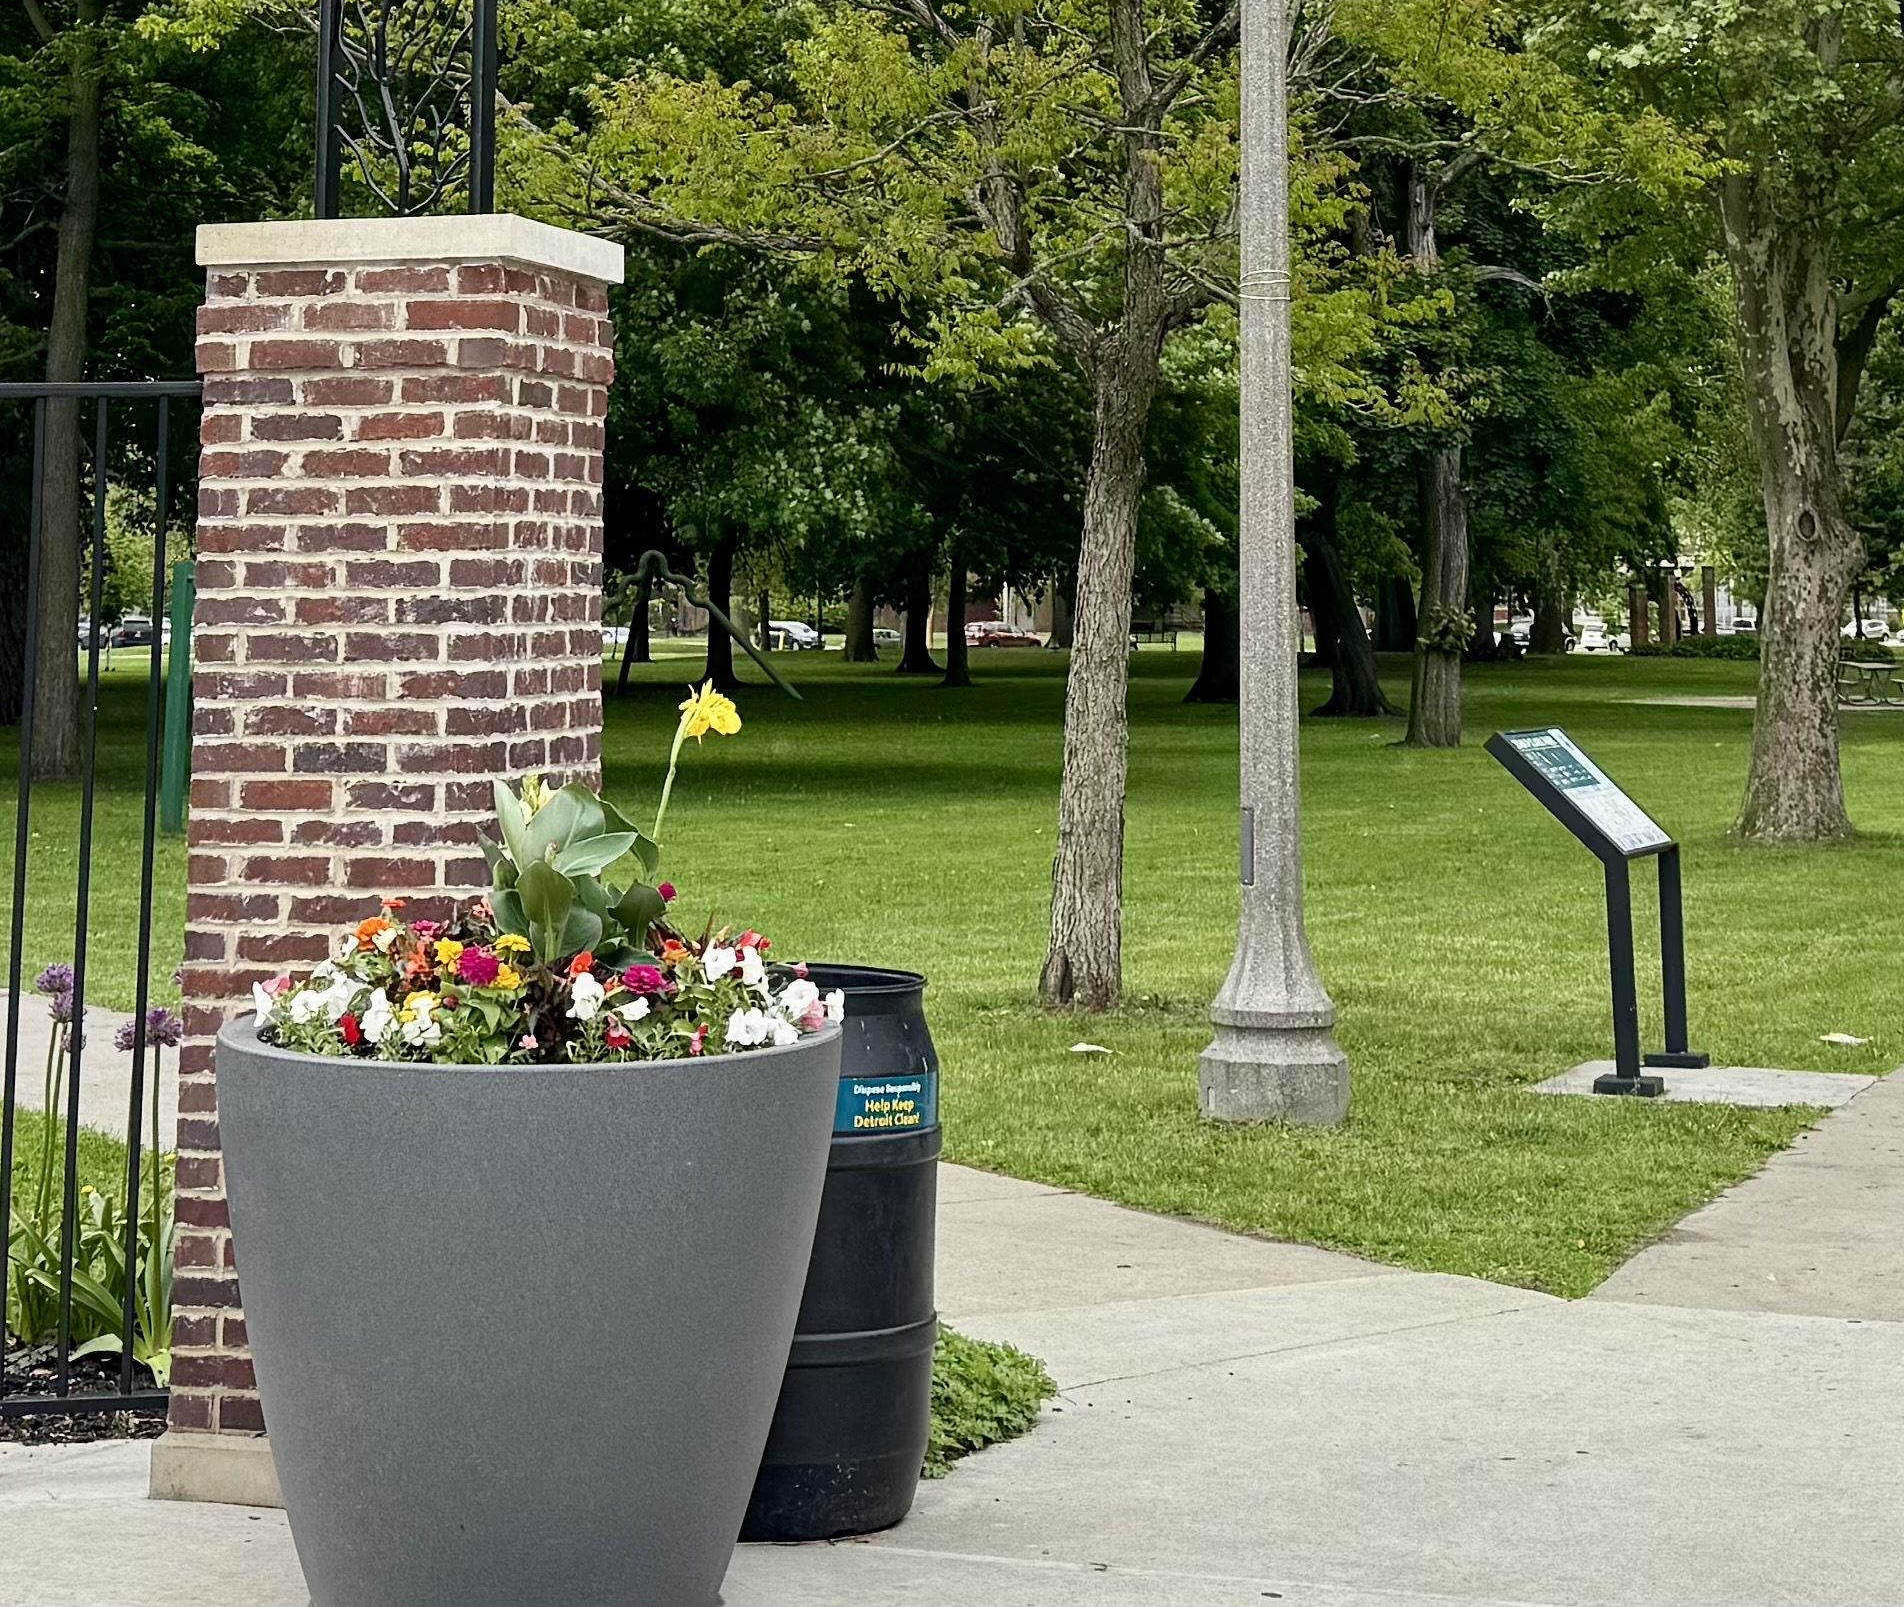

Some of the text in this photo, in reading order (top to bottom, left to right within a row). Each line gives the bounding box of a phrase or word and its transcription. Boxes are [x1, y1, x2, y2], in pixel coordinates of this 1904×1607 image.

[853, 1084, 885, 1097] Dispose
[865, 1098, 914, 1114] Help Keep
[853, 1114, 893, 1128] Detroit
